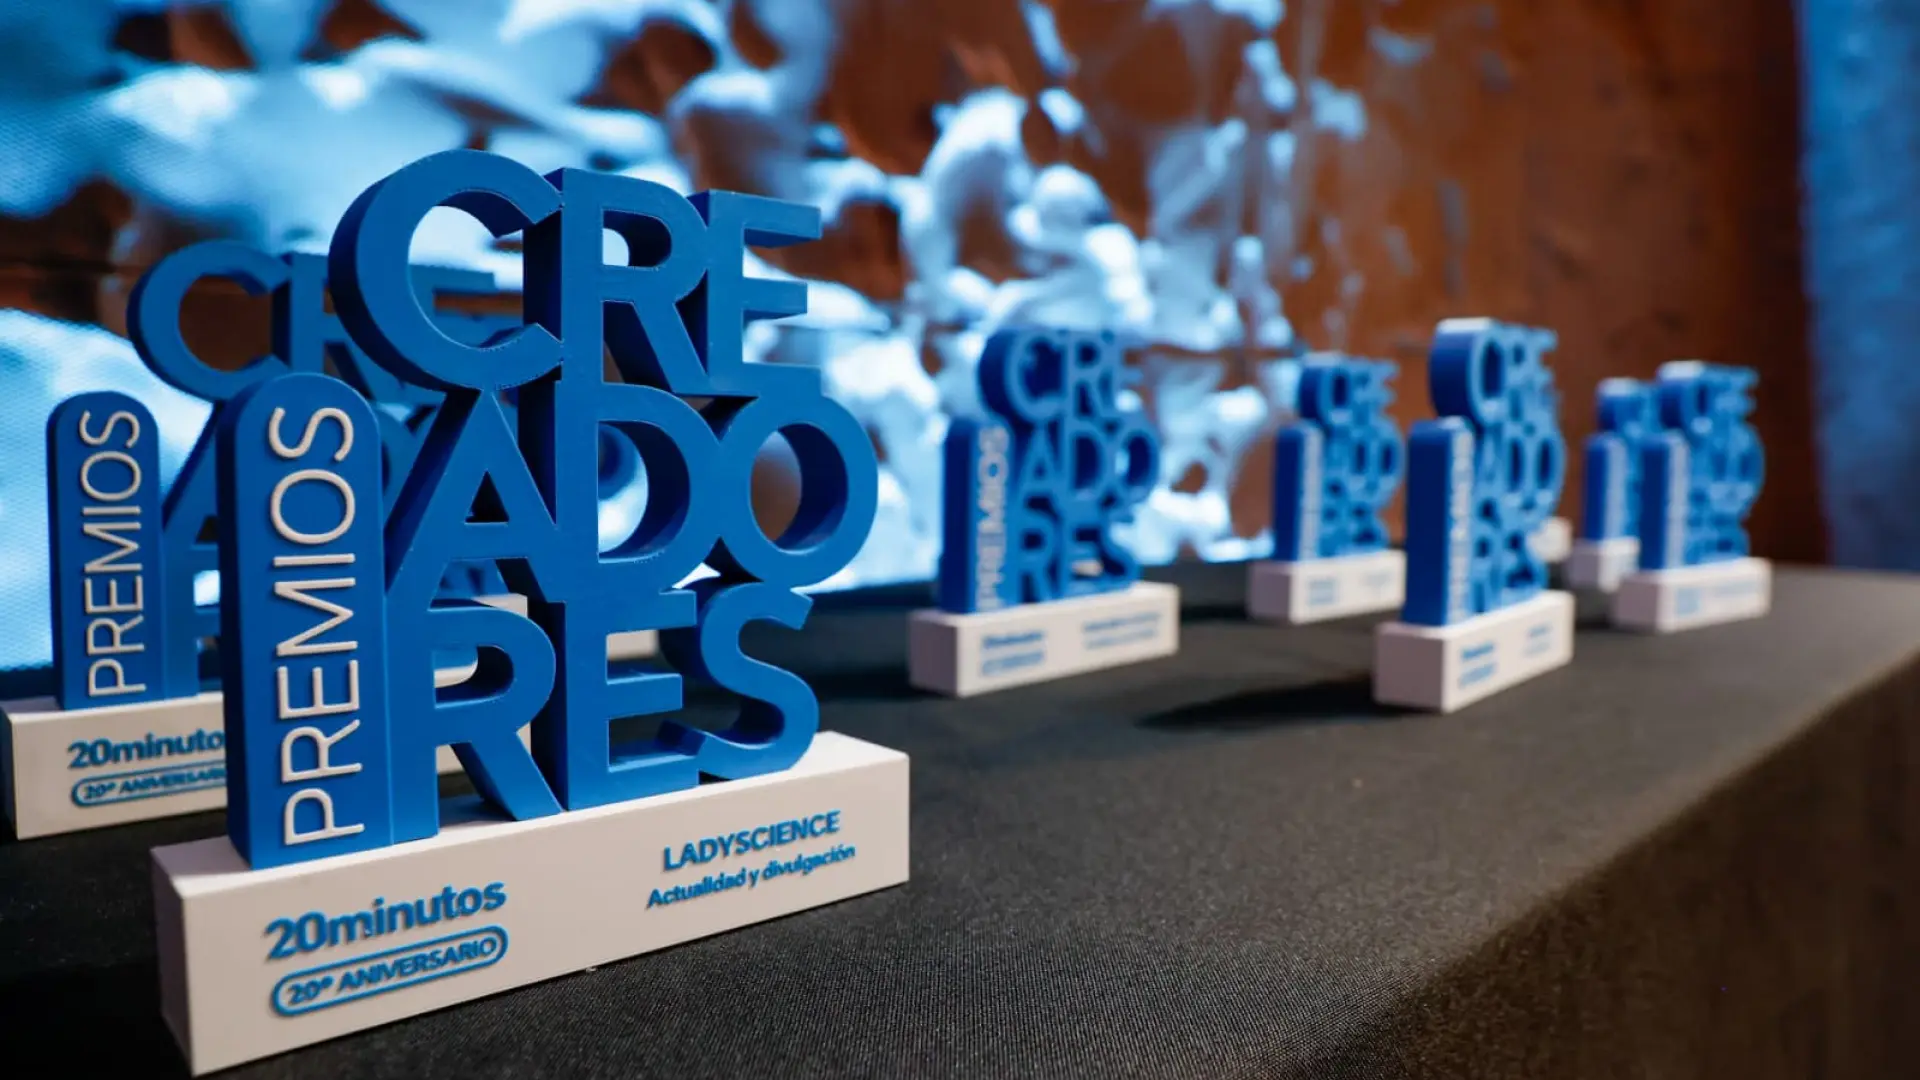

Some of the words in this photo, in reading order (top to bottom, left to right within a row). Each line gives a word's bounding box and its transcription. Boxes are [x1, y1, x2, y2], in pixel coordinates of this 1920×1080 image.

[79, 410, 147, 698] PREMIOS
[269, 407, 365, 846] PREMIOS
[66, 727, 226, 770] 20minuto
[662, 809, 841, 873] LADYSCIENCE
[645, 866, 747, 909] Actualidad
[748, 867, 760, 889] y
[762, 843, 856, 881] divulgación
[264, 881, 507, 962] 20minutos
[337, 935, 498, 993] ANIVERSARIO
